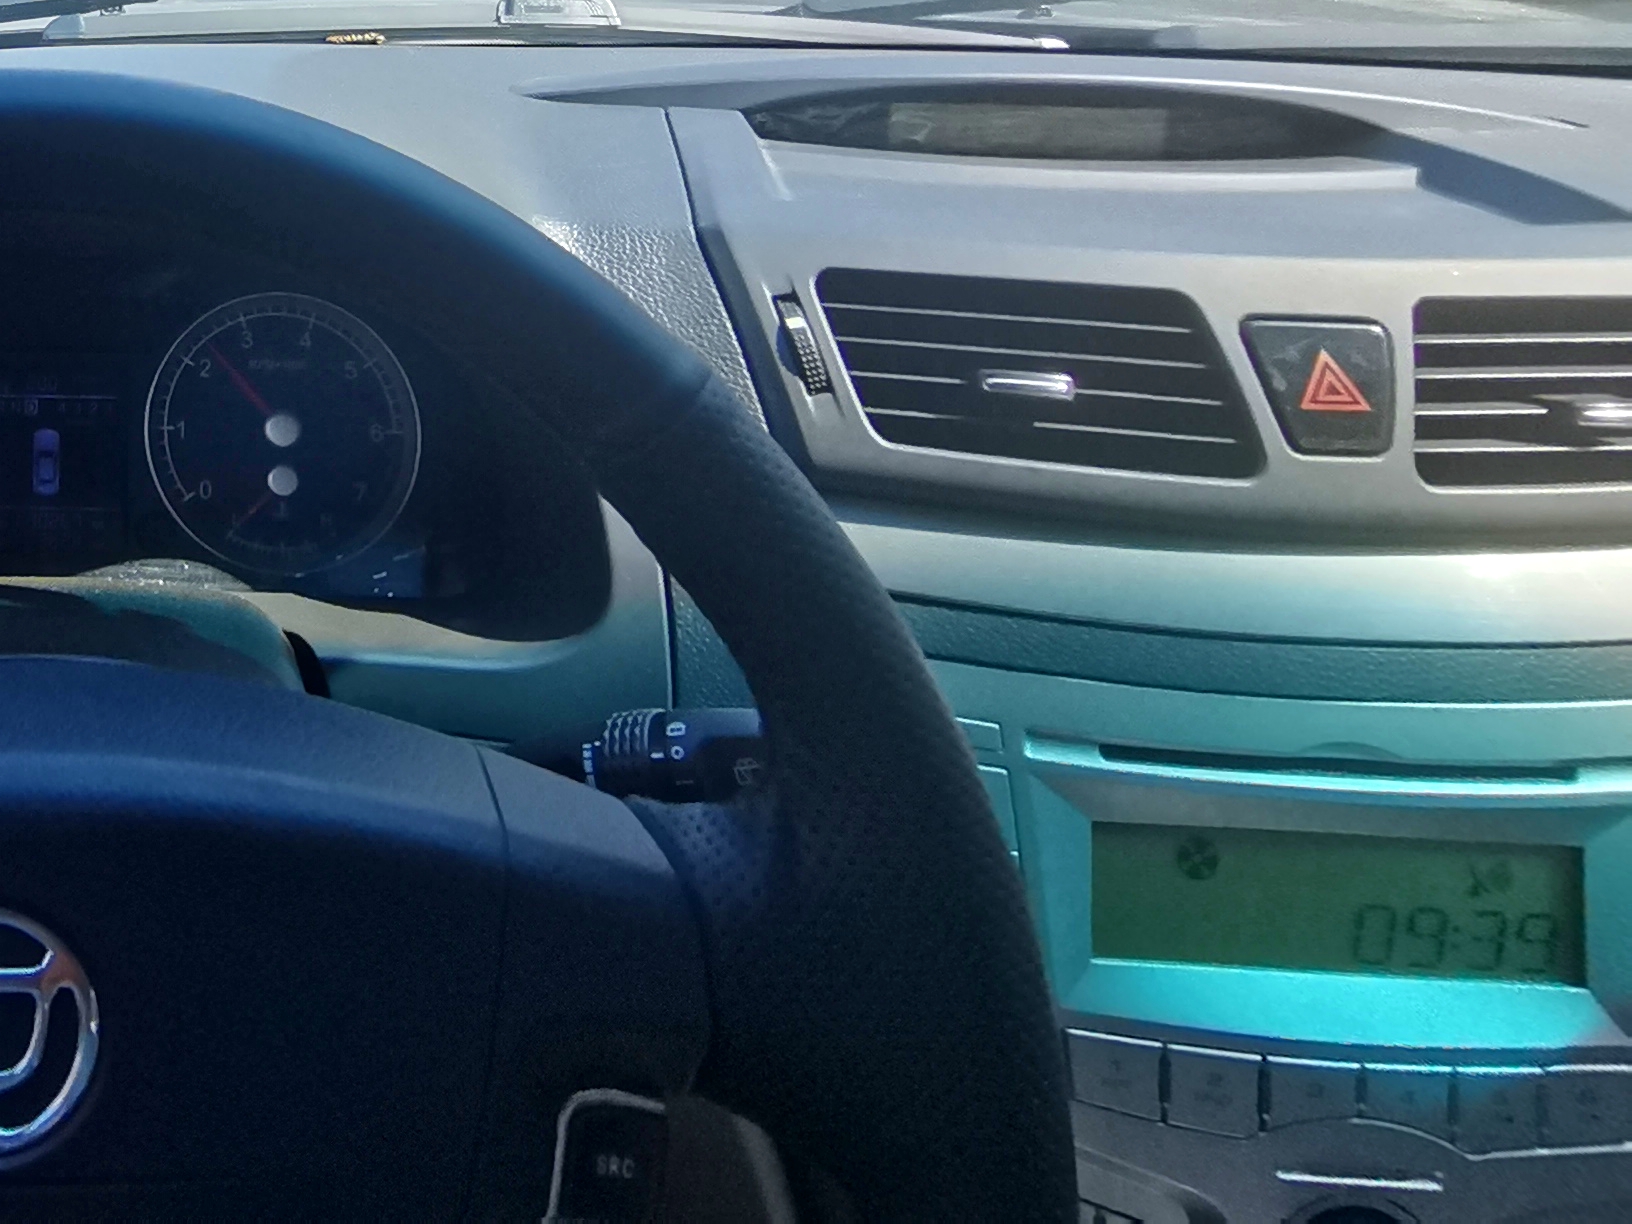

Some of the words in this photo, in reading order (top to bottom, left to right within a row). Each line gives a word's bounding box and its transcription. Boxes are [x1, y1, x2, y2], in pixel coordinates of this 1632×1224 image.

[241, 331, 253, 349] 3
[299, 331, 311, 348] 4
[199, 360, 211, 378] 2
[345, 361, 357, 378] 5
[370, 425, 384, 443] 6
[200, 480, 212, 499] 0
[1351, 902, 1560, 975] 09:39
[596, 1154, 635, 1179] SRC
